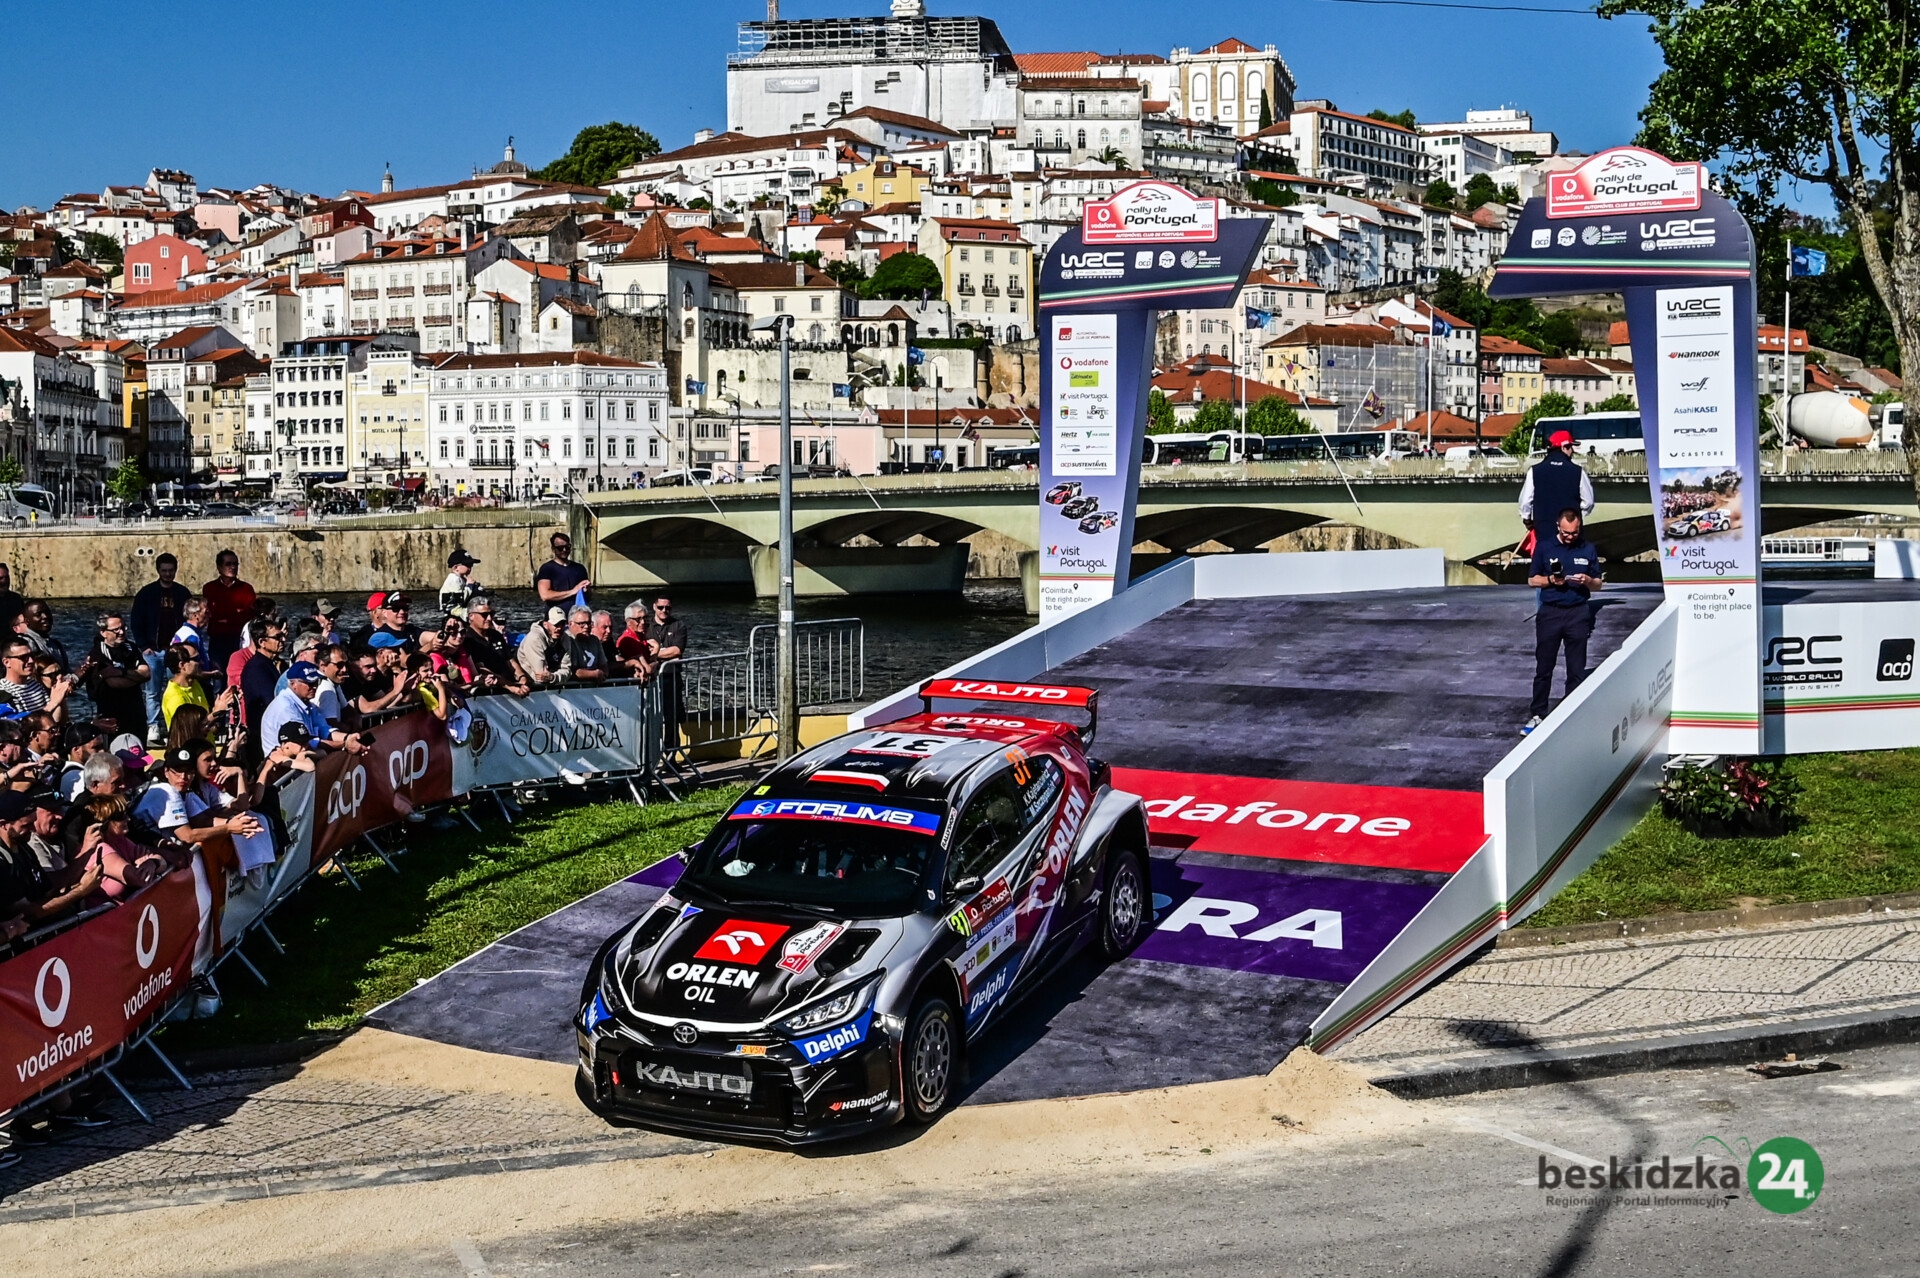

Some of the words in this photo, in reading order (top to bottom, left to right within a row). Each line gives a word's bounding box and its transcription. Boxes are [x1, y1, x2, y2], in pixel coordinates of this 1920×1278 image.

[1595, 174, 1624, 183] rally
[1627, 174, 1642, 182] de
[1593, 180, 1678, 196] Portugal
[1126, 206, 1151, 214] rally
[1124, 213, 1198, 226] Portugal
[1640, 218, 1715, 239] WRC
[1061, 252, 1124, 268] WRC
[1667, 298, 1720, 311] WRC
[1074, 358, 1109, 366] vodafone
[1080, 393, 1109, 402] Portugal
[1060, 546, 1080, 555] visit
[1682, 546, 1706, 557] visit
[1060, 557, 1107, 573] Portugal
[1682, 559, 1739, 576] Portugal
[1687, 593, 1728, 601] #Coimbra,
[1708, 603, 1727, 612] right
[1729, 602, 1752, 611] place
[1882, 662, 1911, 678] acp
[950, 681, 1068, 699] KAJTO
[563, 706, 622, 723] MUNICIPAL
[933, 716, 1026, 729] ORLEN
[511, 722, 623, 757] COIMBRA
[872, 737, 944, 752] 31
[1005, 748, 1032, 786] 31
[327, 764, 366, 824] acp
[776, 801, 914, 825] FORUM8
[1144, 796, 1411, 836] dafone
[1049, 785, 1086, 874] ORLEN
[982, 886, 1009, 913] Portugal
[951, 910, 970, 937] 31
[800, 929, 829, 954] Portugal
[666, 962, 760, 989] ORLEN
[123, 966, 172, 1020] vodafone
[684, 985, 716, 1003] OIL
[970, 968, 1006, 1014] Delphi
[804, 1024, 861, 1059] Delphi
[16, 1024, 93, 1083] vodafone
[636, 1060, 749, 1094] KAJTO
